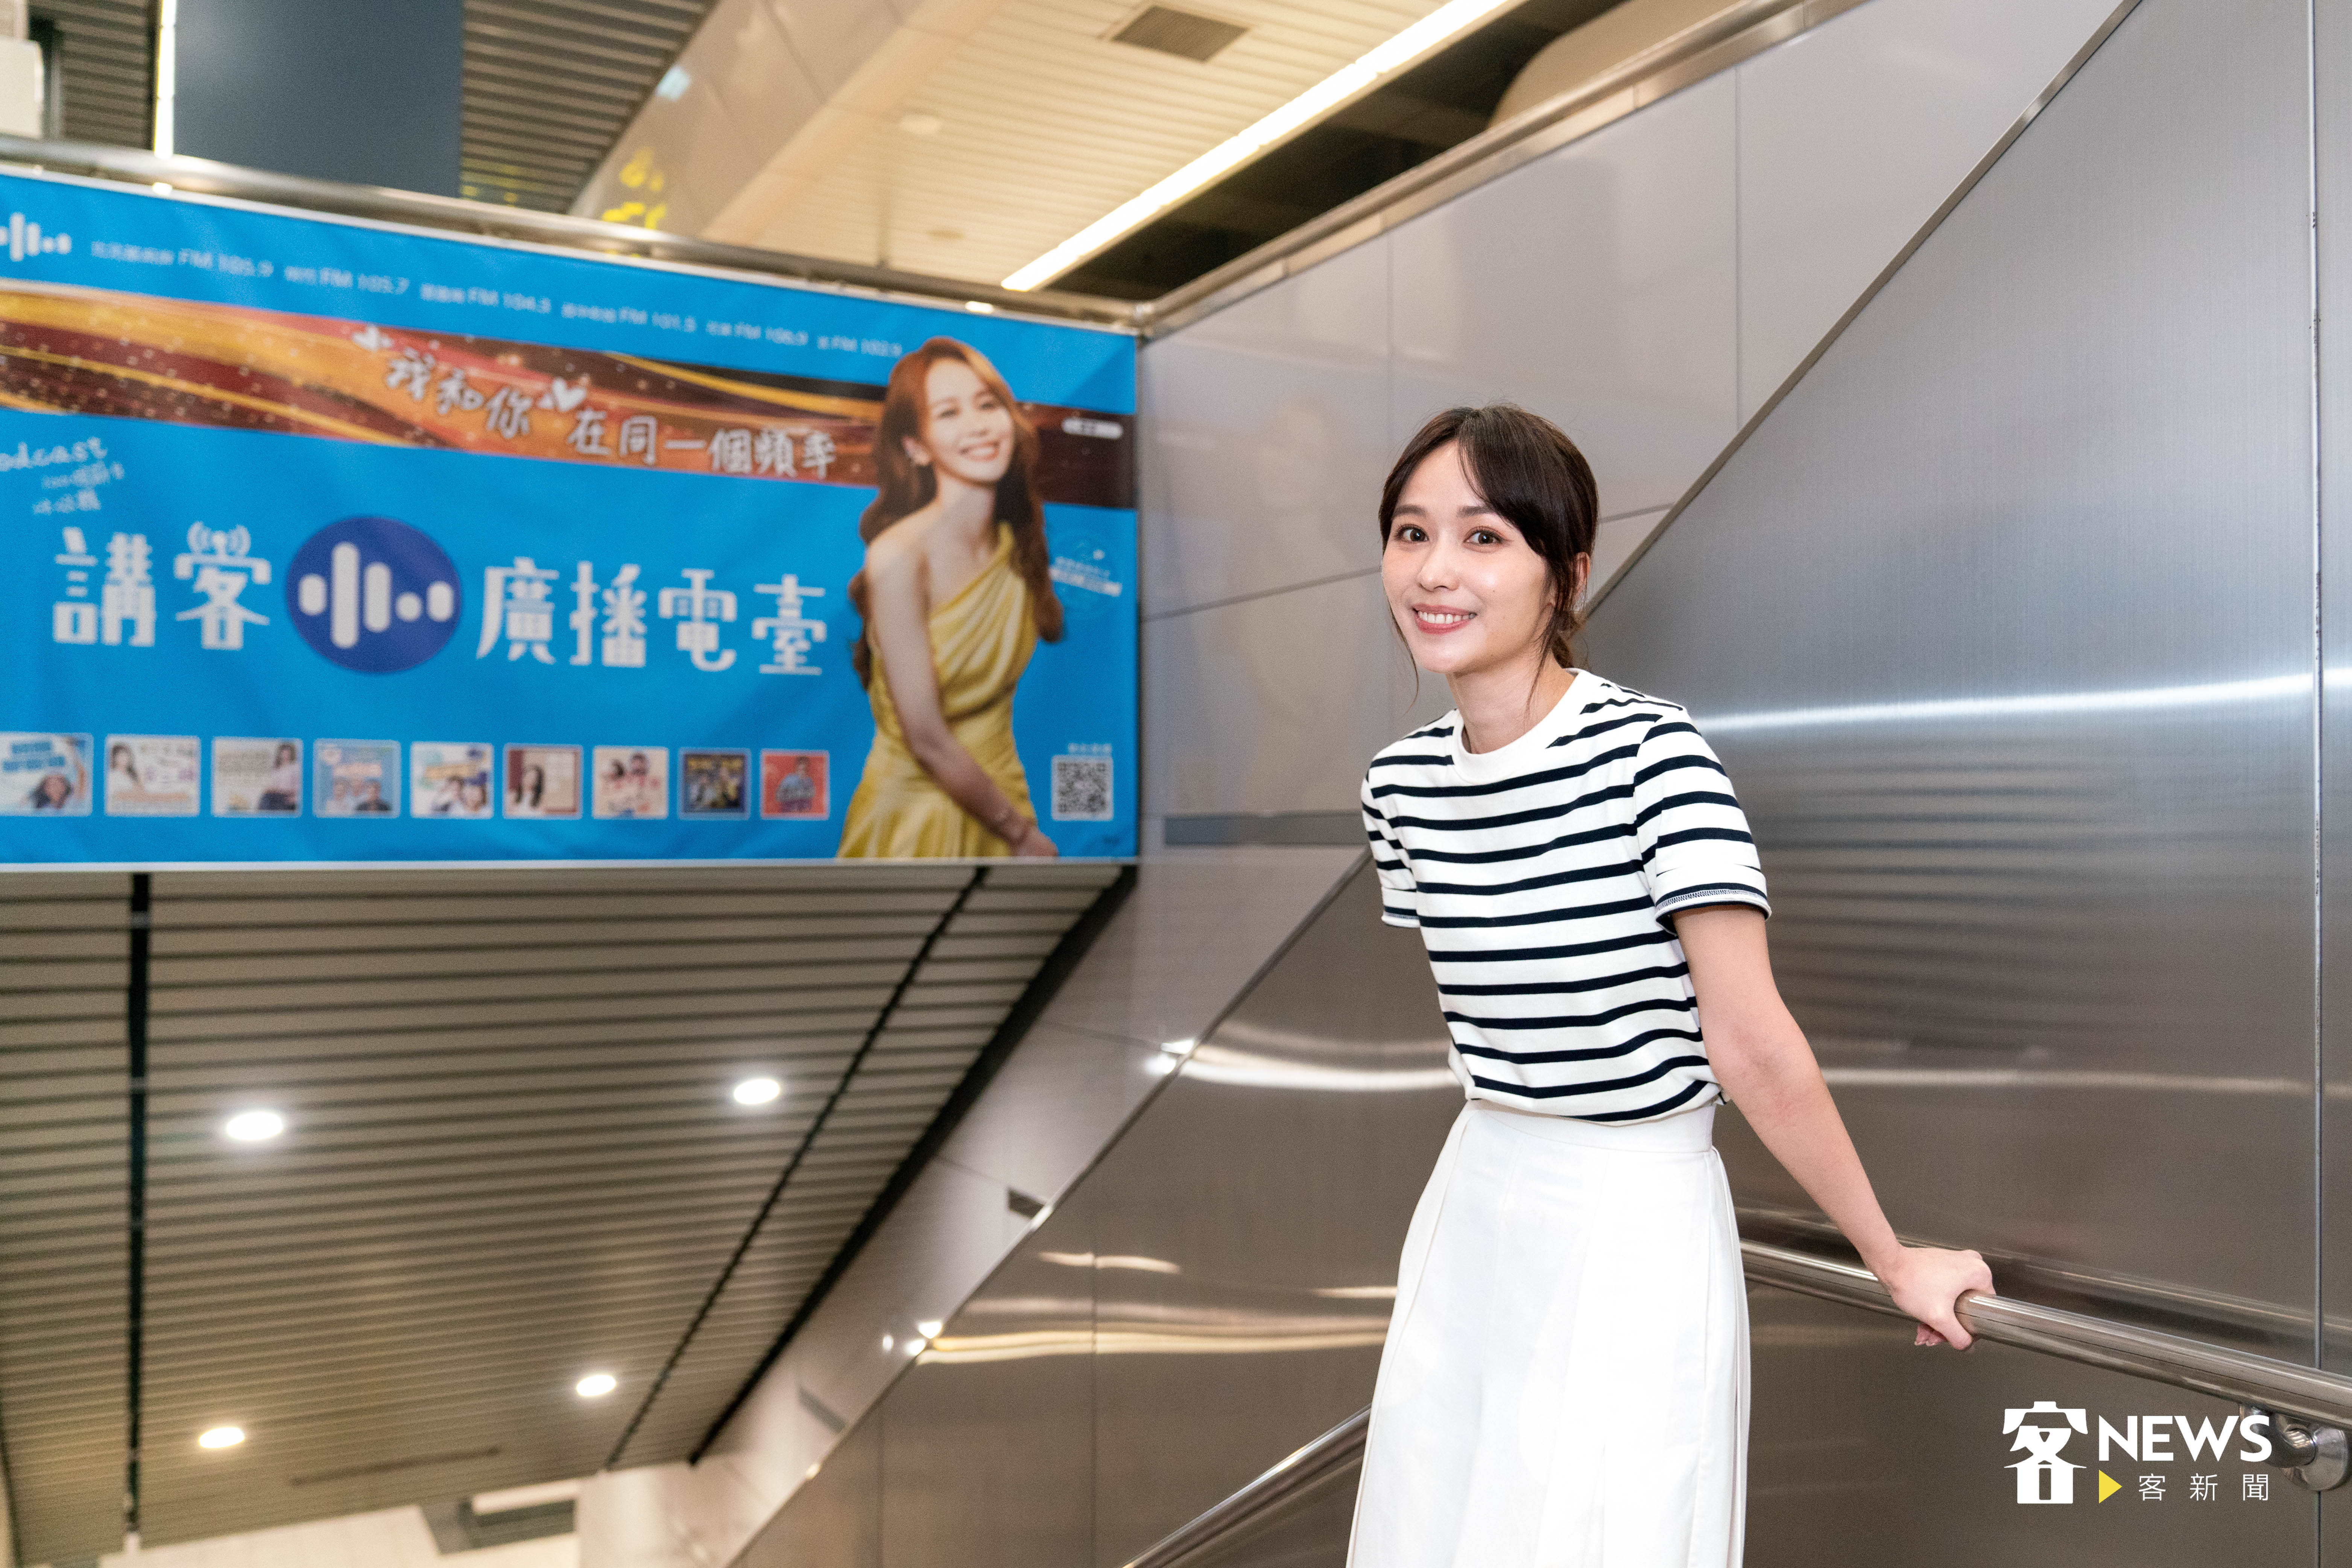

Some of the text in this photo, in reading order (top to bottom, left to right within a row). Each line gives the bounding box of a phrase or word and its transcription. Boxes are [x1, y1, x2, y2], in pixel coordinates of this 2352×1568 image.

[178, 249, 213, 269] FM
[319, 266, 353, 288] FM
[468, 287, 499, 306] FM
[619, 307, 647, 325] FM
[734, 322, 761, 339] FM
[831, 336, 857, 352] FM
[385, 347, 837, 479] 我和你 在同一個頻率
[52, 521, 827, 676] 講客 廣播電臺
